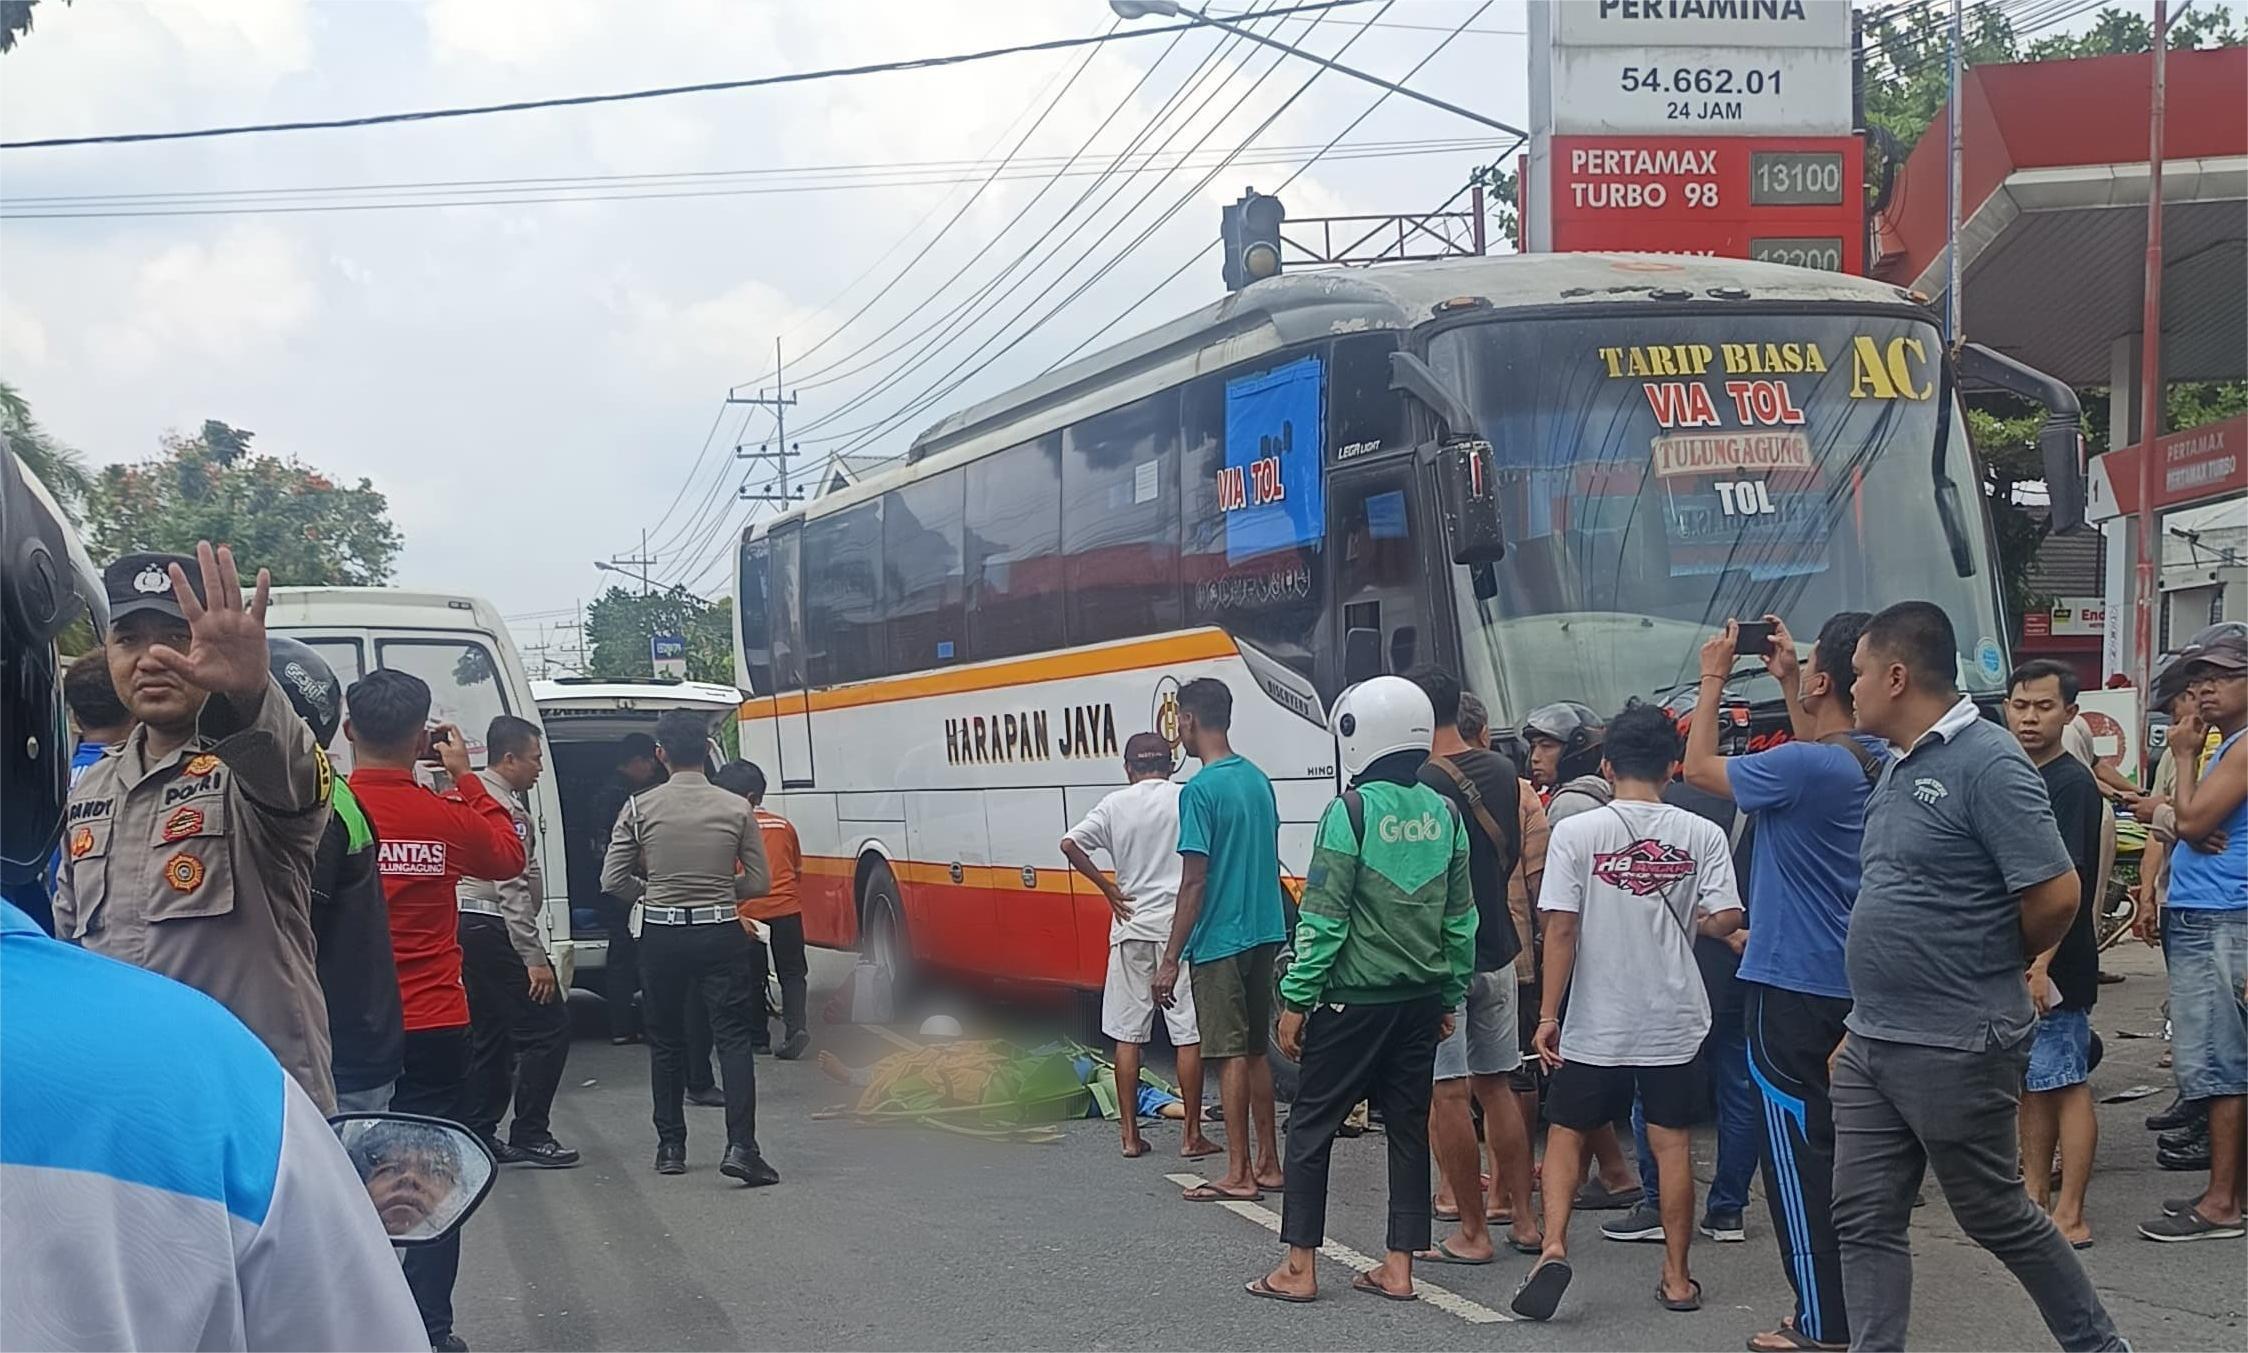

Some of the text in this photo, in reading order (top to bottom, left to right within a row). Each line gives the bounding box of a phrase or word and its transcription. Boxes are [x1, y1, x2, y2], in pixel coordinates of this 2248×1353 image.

[1599, 0, 1807, 20] PERTAMINA
[1620, 67, 1782, 95] 54.662.01
[1666, 101, 1743, 120] 24 JAM
[1571, 150, 1718, 174] PERTAMAX
[1757, 163, 1840, 192] 13100
[1571, 183, 1719, 208] TURBO 98
[1599, 343, 1828, 378] TARIP BIASA
[1849, 335, 1934, 401] AC
[1643, 381, 1806, 428] VIA TOL
[1659, 436, 1804, 469] TULUNGAGUNG
[1217, 456, 1285, 512] VIA TOL
[1713, 480, 1776, 515] TOL
[945, 703, 1118, 765] HARAPAN JAYA
[1307, 765, 1334, 776] HINO
[1378, 812, 1443, 844] Grab
[378, 843, 444, 863] ANTAS
[379, 863, 444, 873] ULUNGAGUNG
